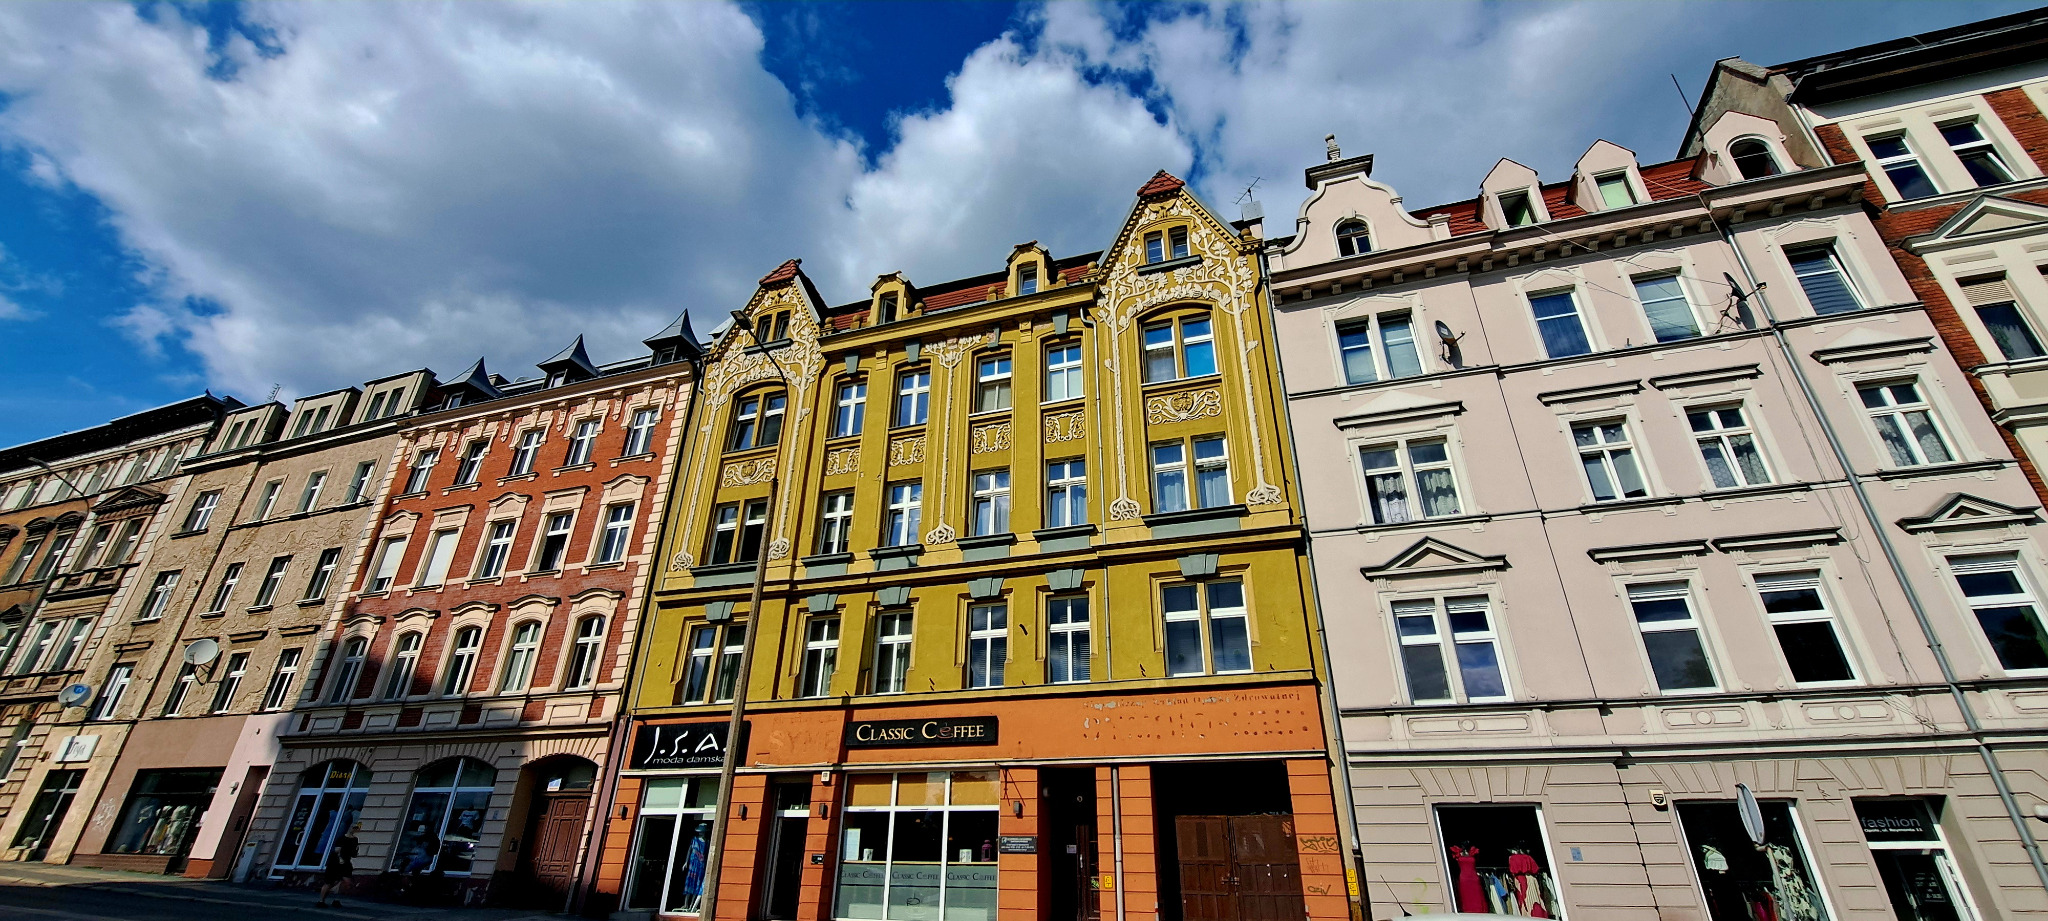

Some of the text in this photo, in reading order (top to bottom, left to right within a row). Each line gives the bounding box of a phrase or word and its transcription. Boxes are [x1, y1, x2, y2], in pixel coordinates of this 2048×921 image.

[856, 724, 914, 741] CLASSIC
[653, 756, 684, 764] moda
[1861, 816, 1921, 828] fashion
